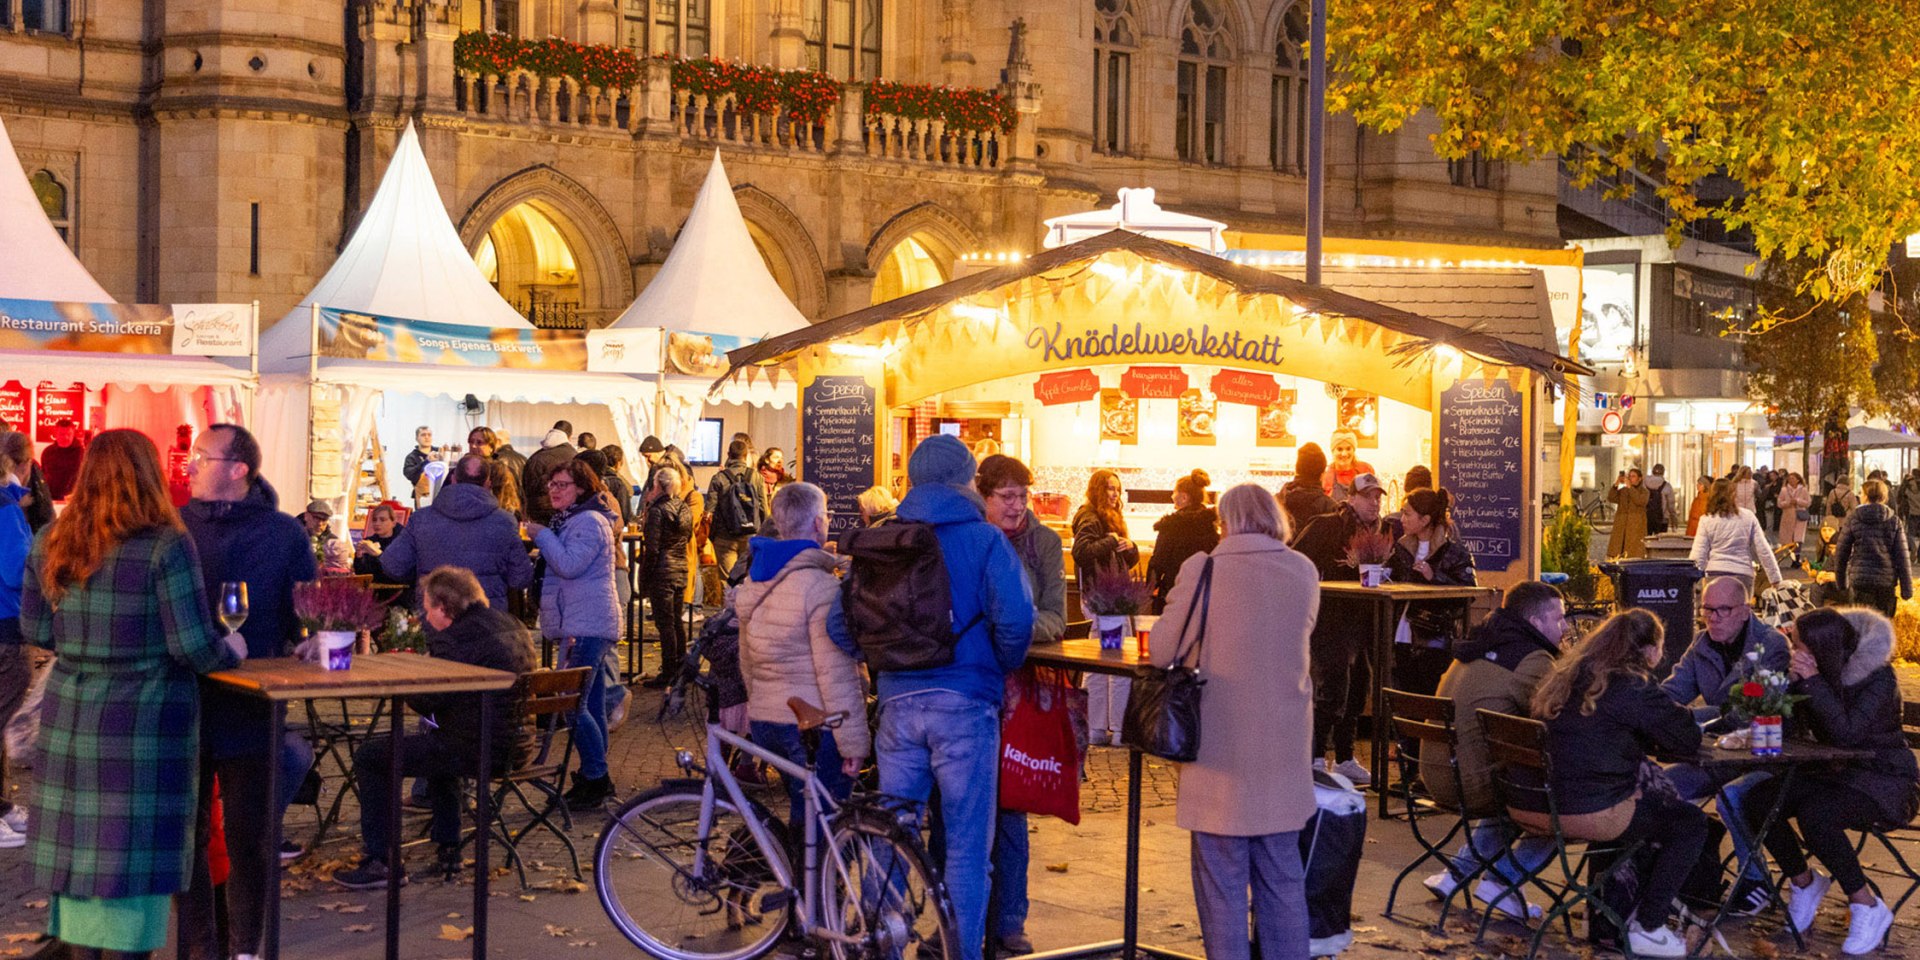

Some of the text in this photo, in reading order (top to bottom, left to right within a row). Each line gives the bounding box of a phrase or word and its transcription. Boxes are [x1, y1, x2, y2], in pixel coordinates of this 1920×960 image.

[1, 315, 162, 335] Restaurant Schickeria
[419, 337, 543, 354] Songs Eigenes Backwerk
[1025, 322, 1284, 366] Knödelwerkstatt
[822, 379, 865, 400] Speisen
[1461, 383, 1506, 405] Speisen
[1507, 406, 1519, 416] 7€
[1502, 435, 1520, 448] 12€
[861, 455, 872, 465] 7€
[1504, 461, 1518, 473] 7€
[1453, 506, 1474, 519] Apple
[1507, 507, 1519, 519] 5€
[848, 518, 861, 530] 5€
[1487, 540, 1506, 553] 5€
[1637, 589, 1666, 598] ALBA
[1004, 743, 1062, 774] katronic
